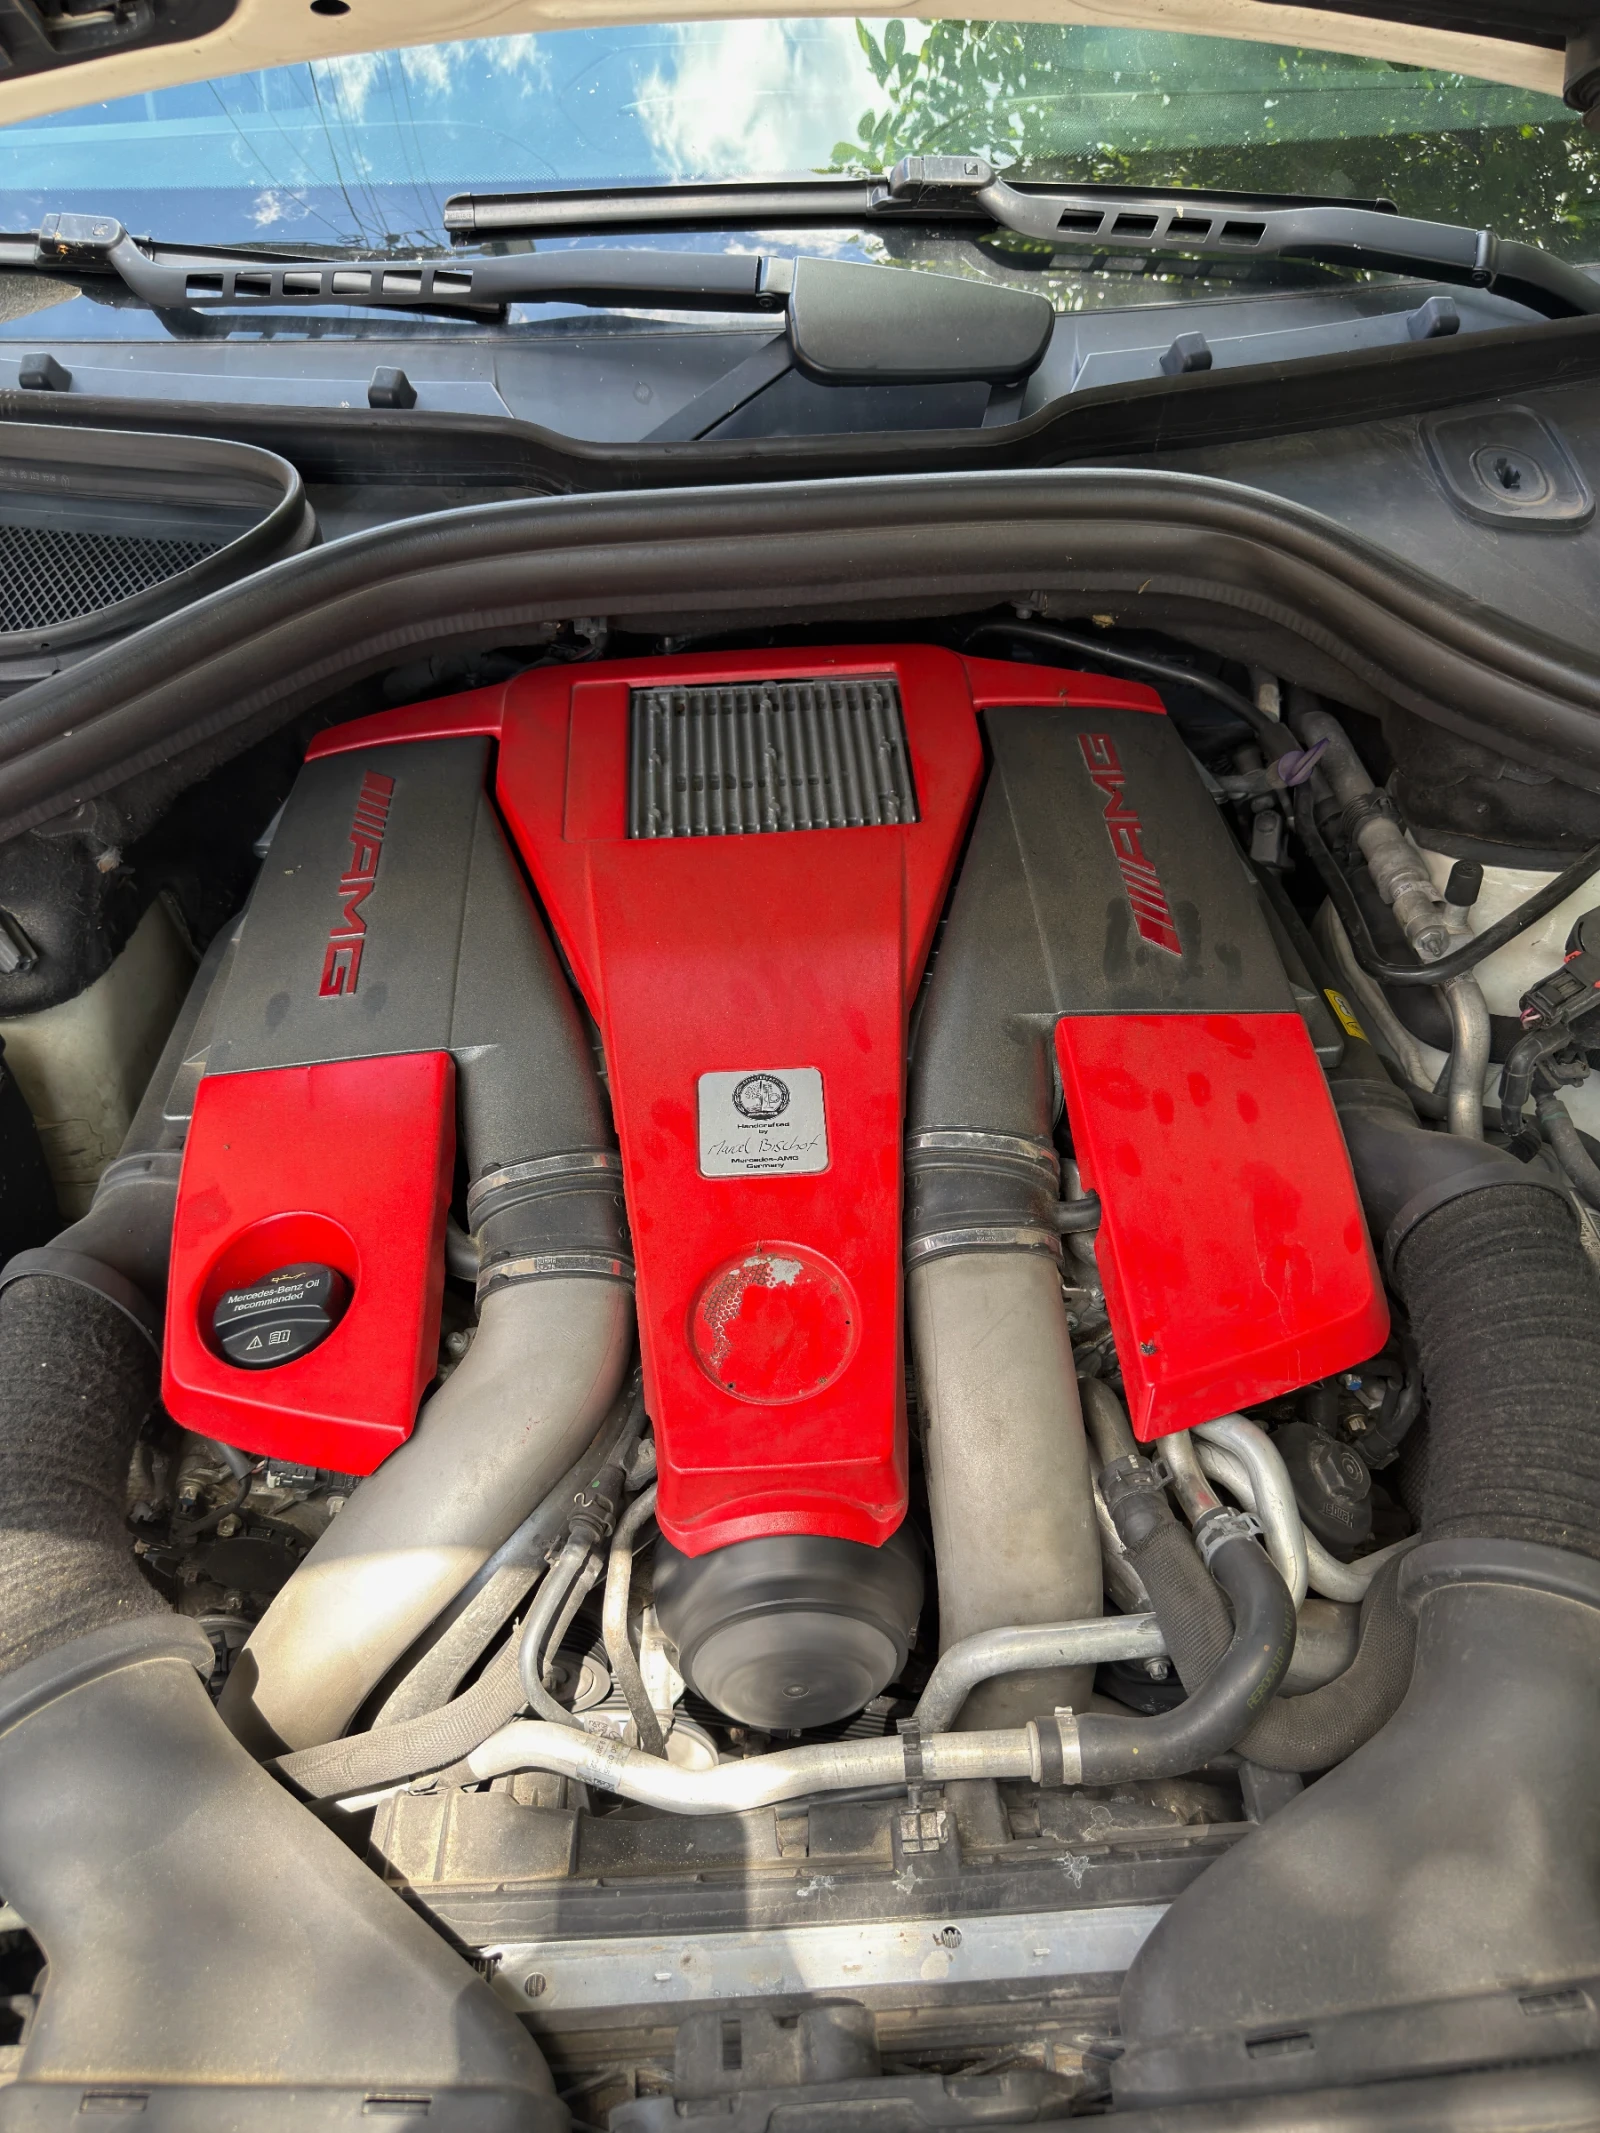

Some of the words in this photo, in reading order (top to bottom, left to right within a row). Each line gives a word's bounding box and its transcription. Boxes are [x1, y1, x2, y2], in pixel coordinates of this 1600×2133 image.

[319, 830, 383, 998] AMG
[731, 1155, 799, 1164] Mercedes-AMG
[227, 1283, 304, 1305] Mercedes-Benz
[305, 1279, 320, 1289] Oil
[233, 1291, 304, 1312] recommended
[1246, 1646, 1285, 1710] AEROQUIP
